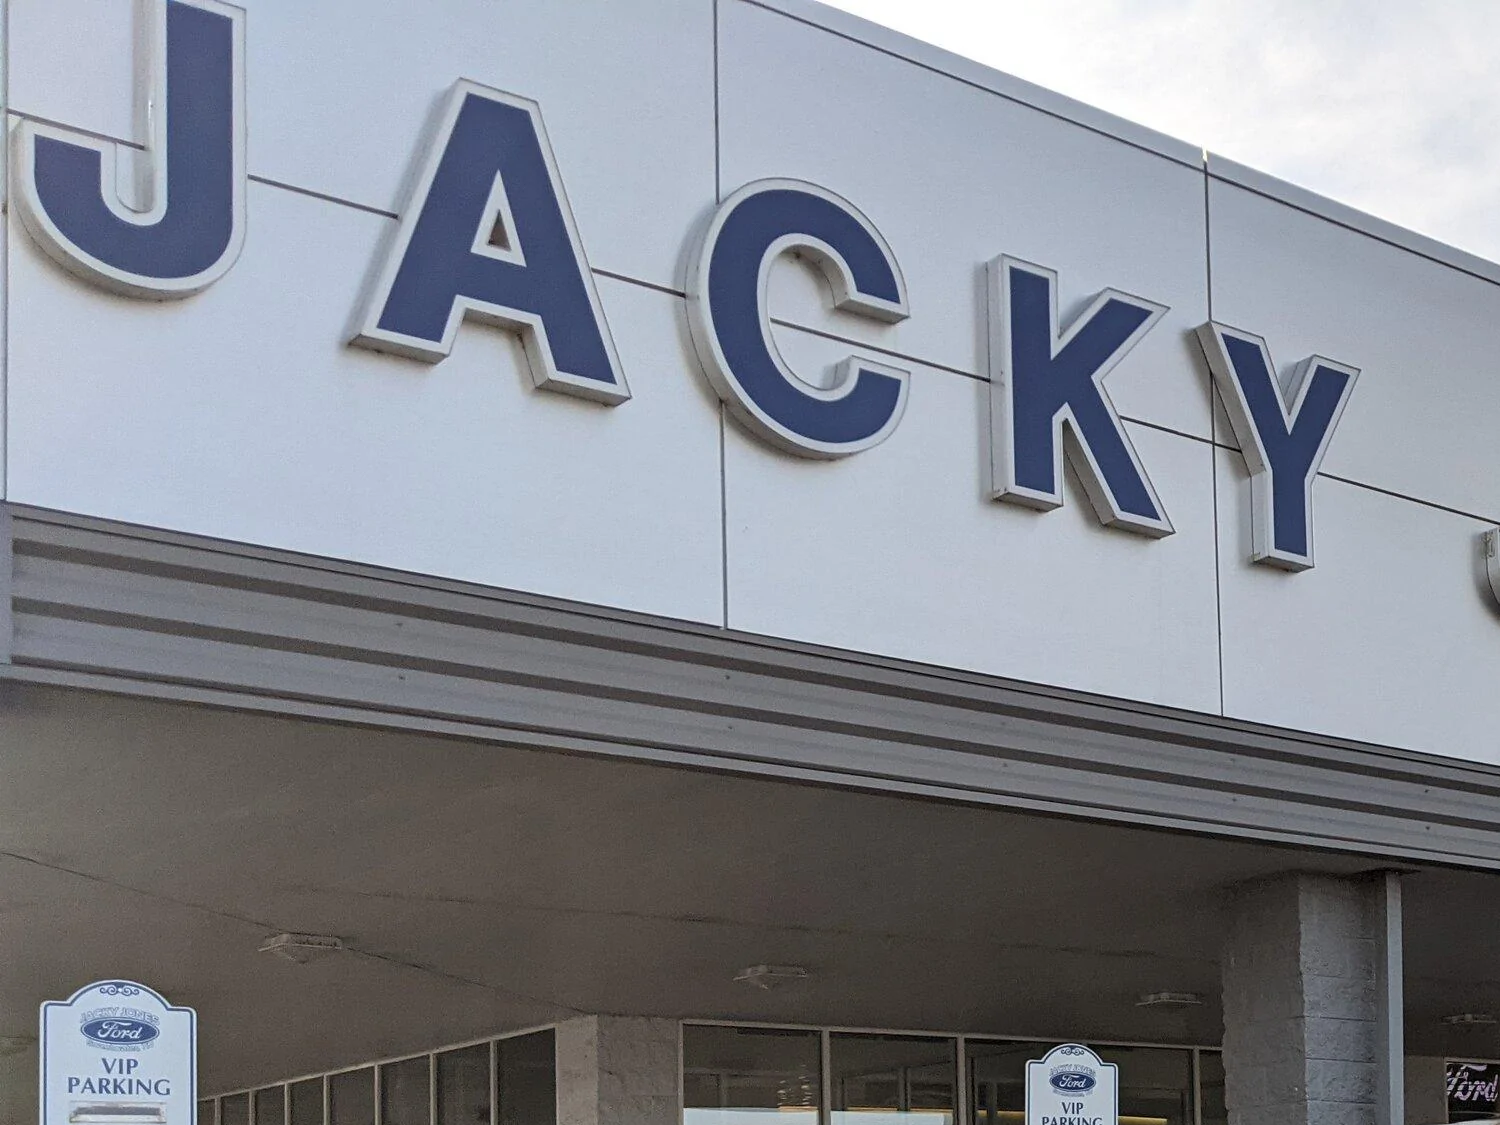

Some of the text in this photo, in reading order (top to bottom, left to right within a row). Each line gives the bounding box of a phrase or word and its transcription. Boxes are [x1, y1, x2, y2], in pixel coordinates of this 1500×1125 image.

[8, 0, 1361, 572] JACKY
[97, 1021, 143, 1039] Ford
[101, 1058, 138, 1075] VIP
[67, 1076, 171, 1096] PARKING
[1059, 1075, 1087, 1088] Ford
[1446, 1064, 1499, 1102] Ford
[1061, 1102, 1084, 1115] VIP
